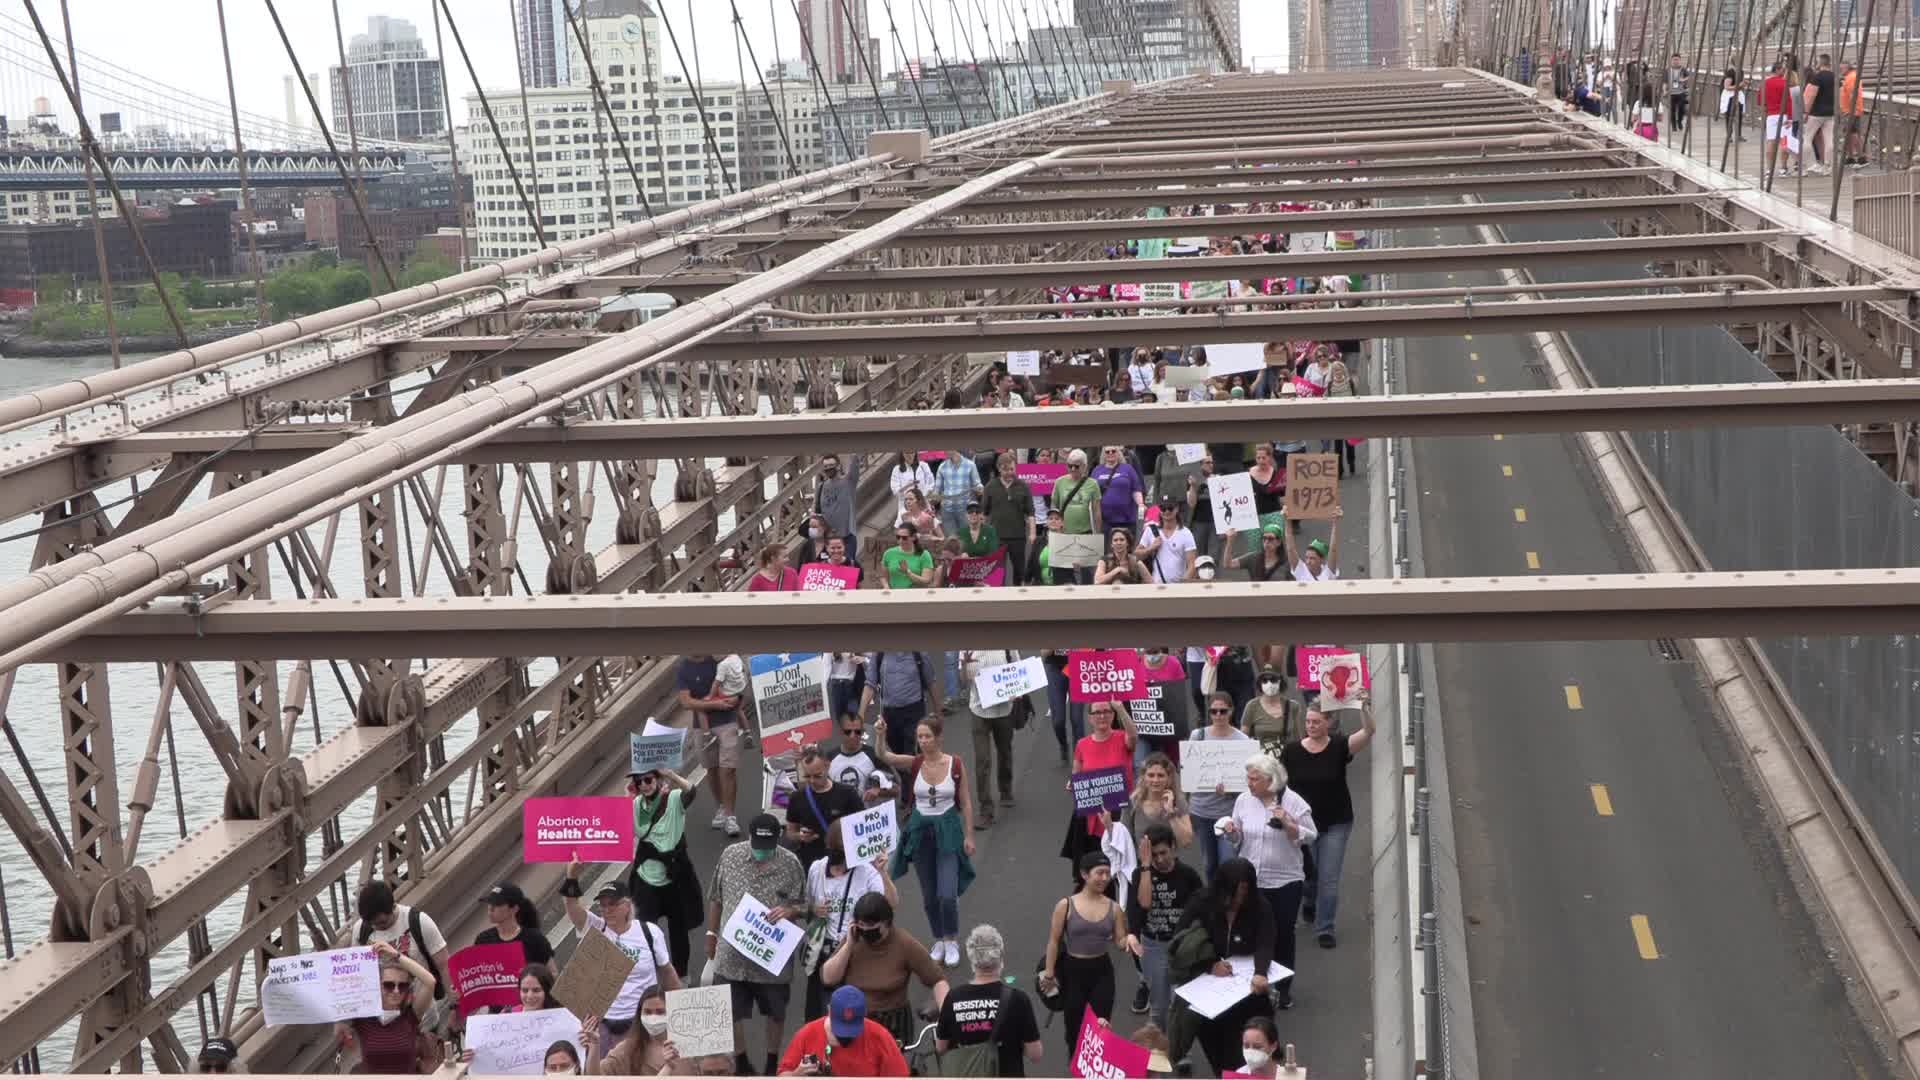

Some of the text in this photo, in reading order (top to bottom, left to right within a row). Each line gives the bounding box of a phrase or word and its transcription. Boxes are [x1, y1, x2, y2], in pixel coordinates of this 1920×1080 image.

[1294, 459, 1336, 479] ROE
[1234, 496, 1248, 505] NO
[1292, 487, 1335, 510] 1973
[807, 568, 832, 577] BANS
[823, 577, 846, 588] OUR
[1080, 660, 1115, 672] BANS
[1080, 669, 1135, 682] OFF OUR
[1081, 680, 1133, 693] BODIES
[1131, 700, 1155, 709] WITH
[1133, 712, 1161, 721] BLACK
[1136, 725, 1173, 734] WOMEN
[1073, 774, 1124, 790] NEW YORKERS
[1075, 783, 1125, 800] FOR ABORTION
[1077, 797, 1104, 809] ACCESS
[537, 815, 601, 827] Abortion is
[864, 811, 880, 822] PRO
[854, 815, 889, 837] UNION
[537, 828, 619, 840] Health Care.
[868, 833, 883, 844] PRO
[744, 908, 785, 943] UNION
[748, 930, 765, 945] PRO
[734, 928, 774, 962] CHOICE
[459, 962, 505, 979] Abortion is
[461, 975, 520, 992] Health Care.
[953, 999, 1000, 1011] RESISTANC
[956, 1011, 987, 1022] BEGINS
[1083, 1023, 1104, 1057] BANS
